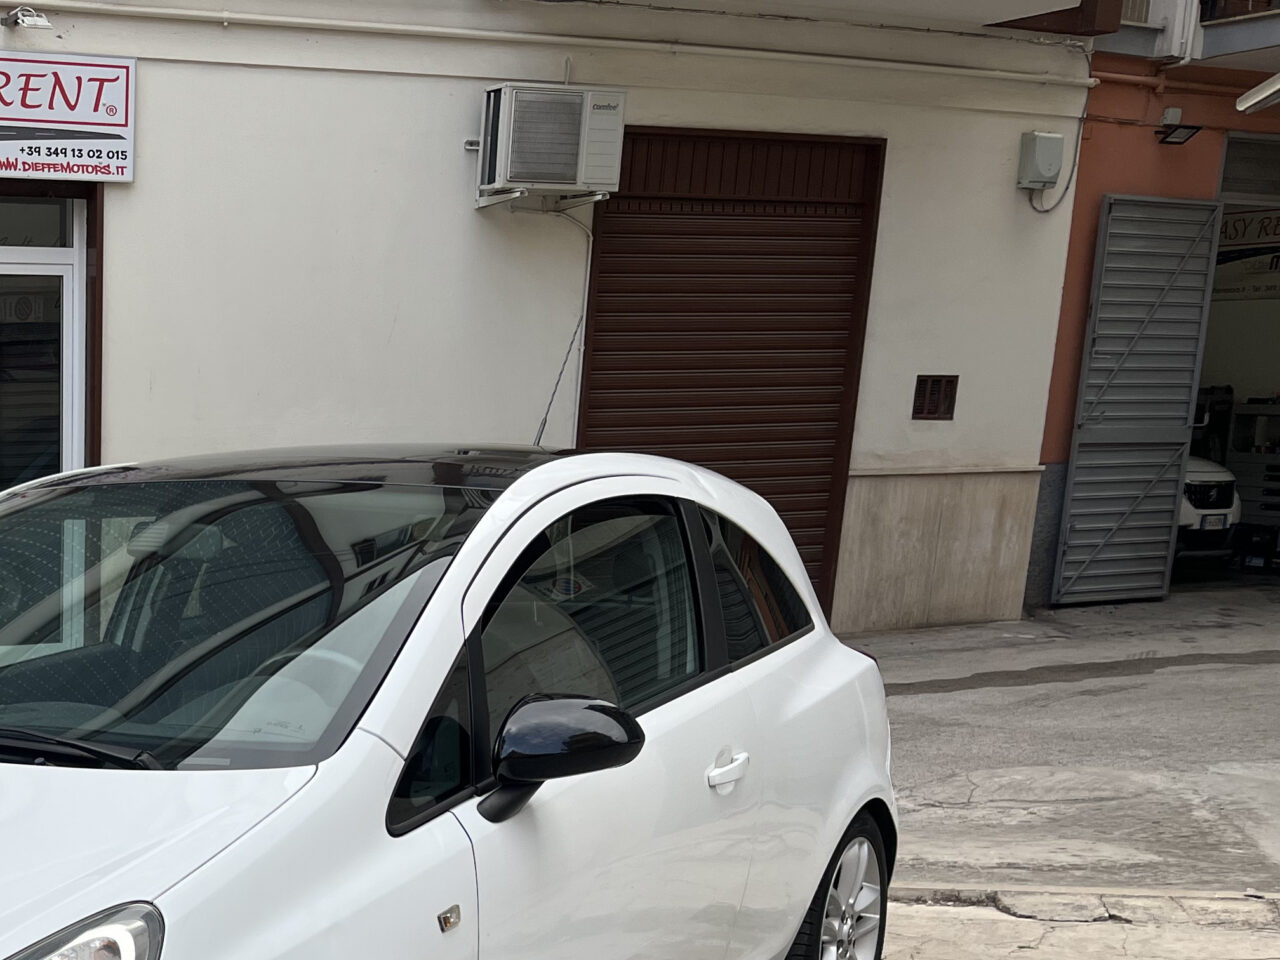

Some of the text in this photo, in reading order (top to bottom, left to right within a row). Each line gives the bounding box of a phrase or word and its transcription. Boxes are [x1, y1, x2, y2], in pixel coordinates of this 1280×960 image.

[19, 146, 128, 160] +39 349 13 02 015
